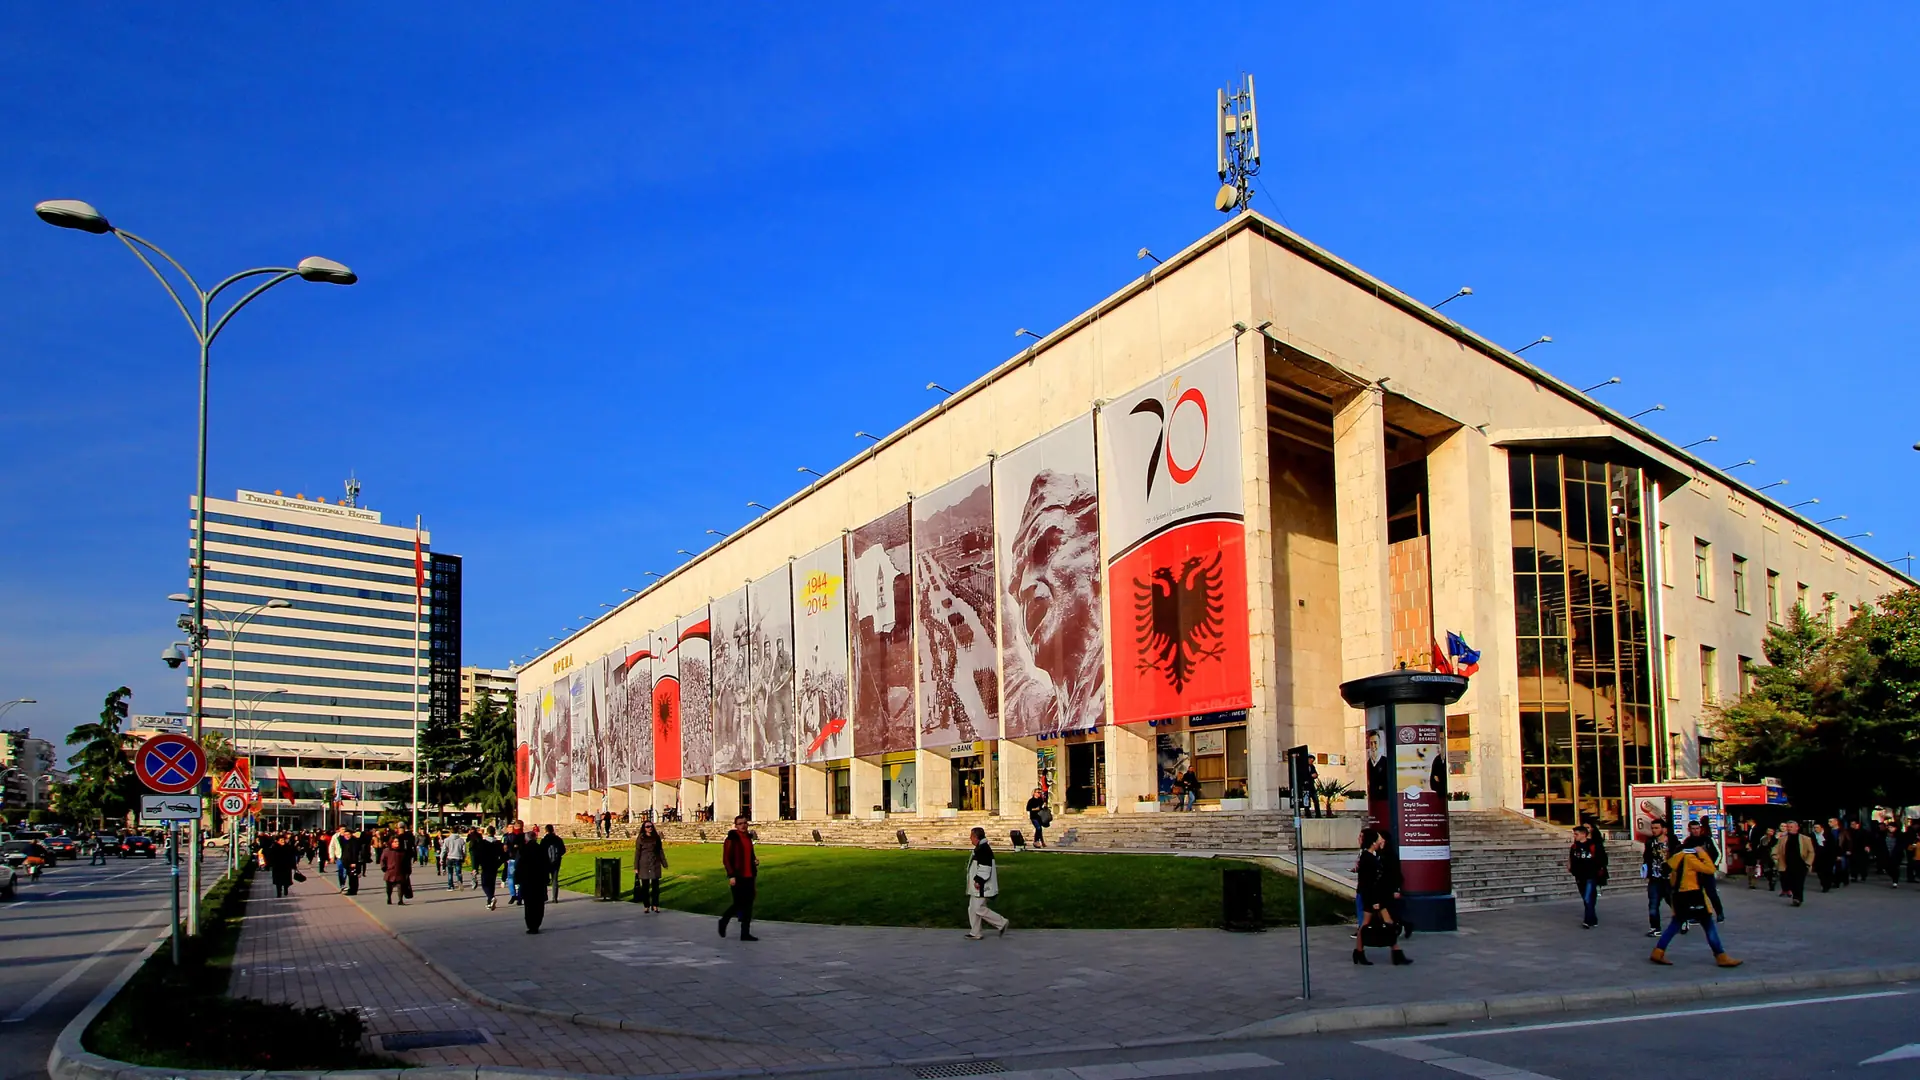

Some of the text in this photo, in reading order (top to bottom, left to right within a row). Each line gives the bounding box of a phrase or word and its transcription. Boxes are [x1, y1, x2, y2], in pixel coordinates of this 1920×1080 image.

[1129, 388, 1208, 504] 70
[282, 500, 345, 515] INTERNATIONAL
[348, 510, 376, 520] HOTEL
[807, 572, 828, 594] 1944
[807, 593, 828, 616] 2014
[553, 653, 574, 674] OPERA
[226, 799, 240, 809] 30
